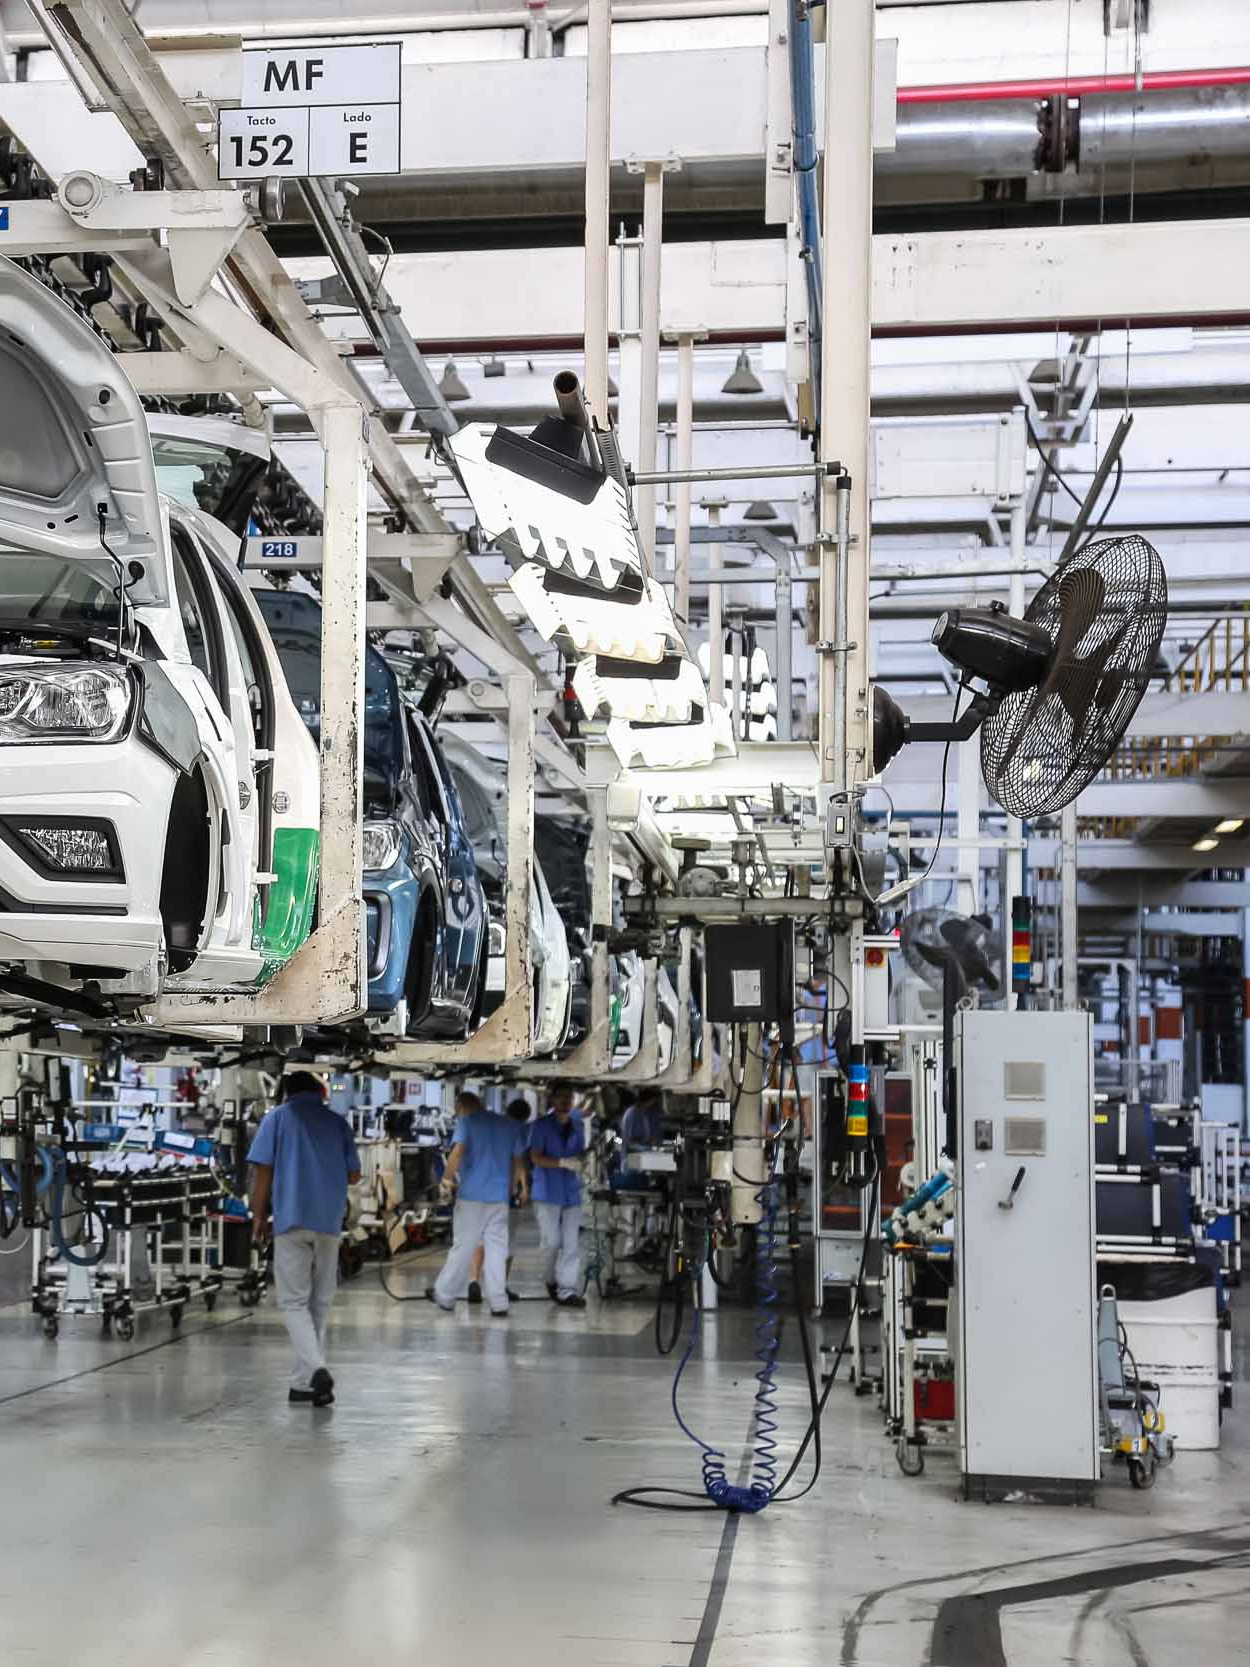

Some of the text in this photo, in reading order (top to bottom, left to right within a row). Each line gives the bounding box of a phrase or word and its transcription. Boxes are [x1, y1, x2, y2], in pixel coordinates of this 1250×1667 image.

[263, 59, 324, 92] MF
[246, 115, 277, 126] Tacto
[343, 111, 372, 123] Lado
[230, 134, 294, 168] 152
[349, 132, 368, 164] E
[265, 543, 294, 556] 218
